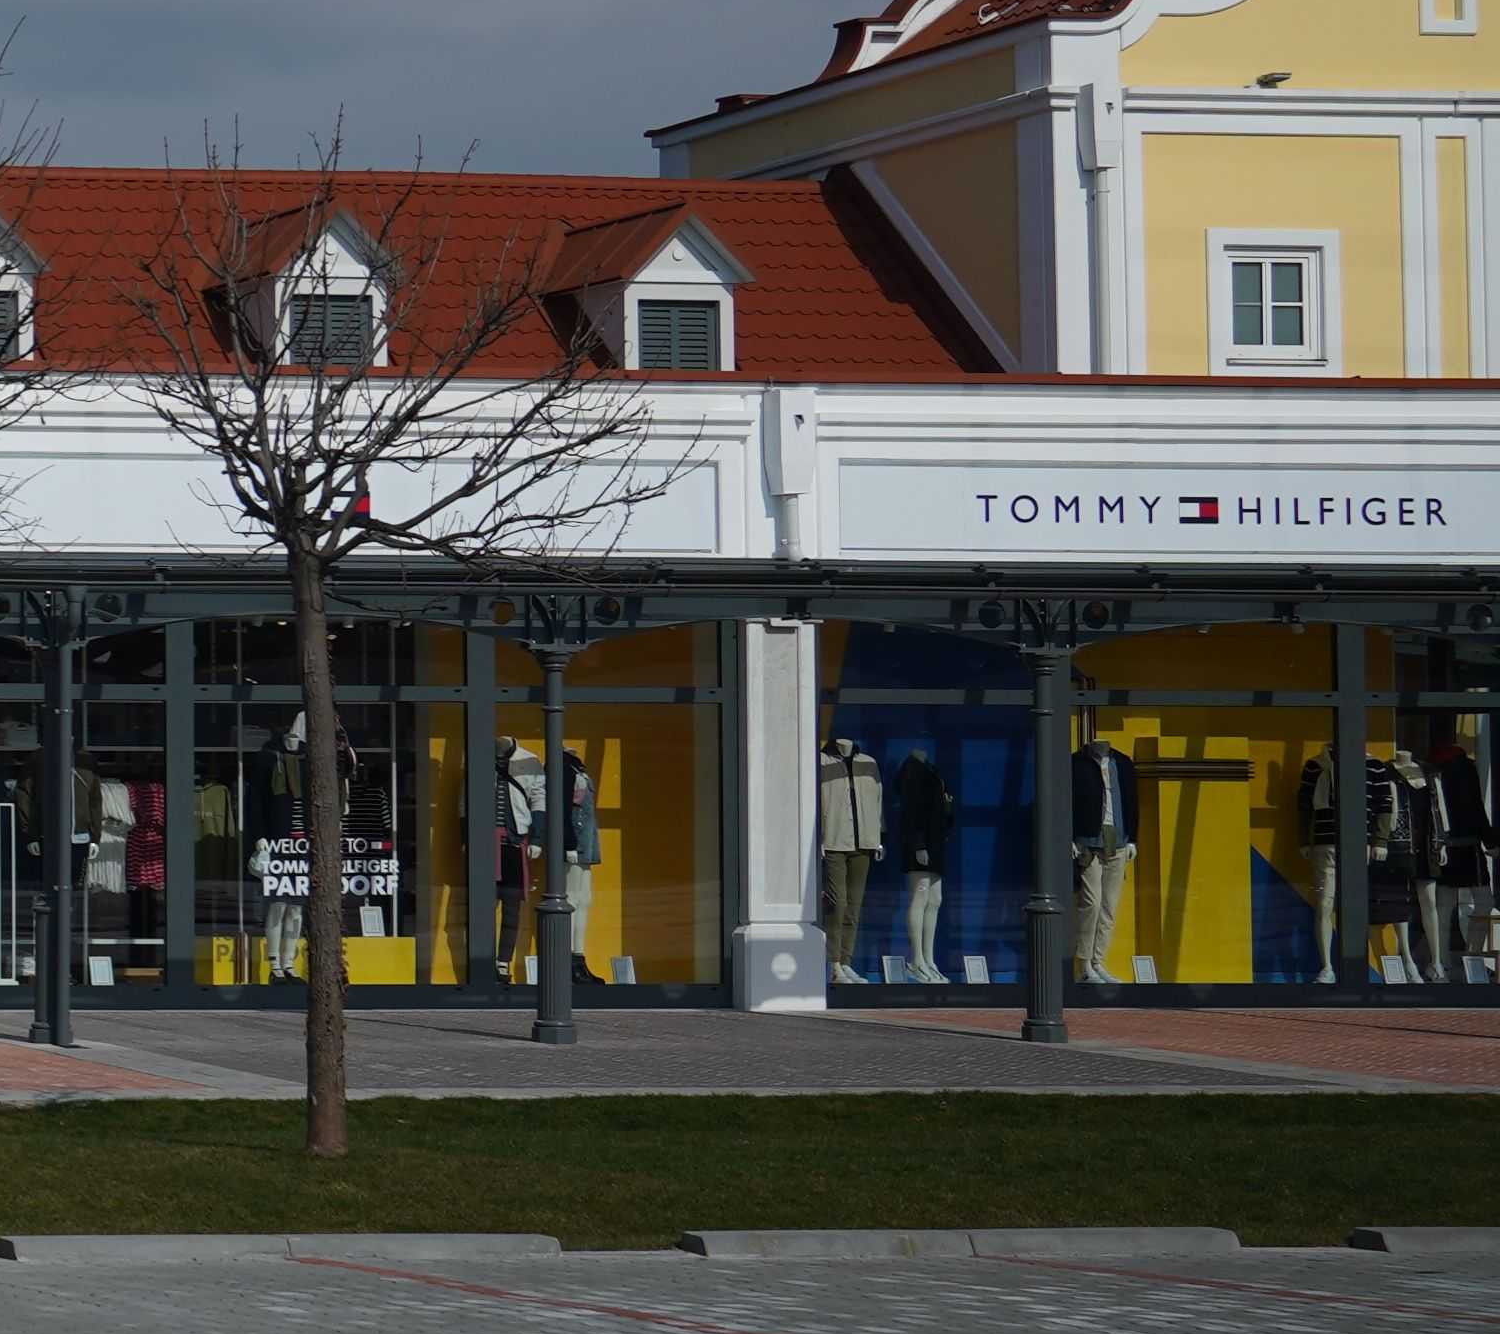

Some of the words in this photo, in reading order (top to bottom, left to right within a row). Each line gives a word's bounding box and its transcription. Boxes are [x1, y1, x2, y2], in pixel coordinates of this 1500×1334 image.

[976, 494, 1162, 525] TOMMY
[1237, 496, 1448, 527] HILFIGER
[347, 838, 368, 854] TO
[263, 859, 309, 874] TOMM
[341, 859, 400, 874] ILFIGER
[263, 875, 399, 896] PARORF
